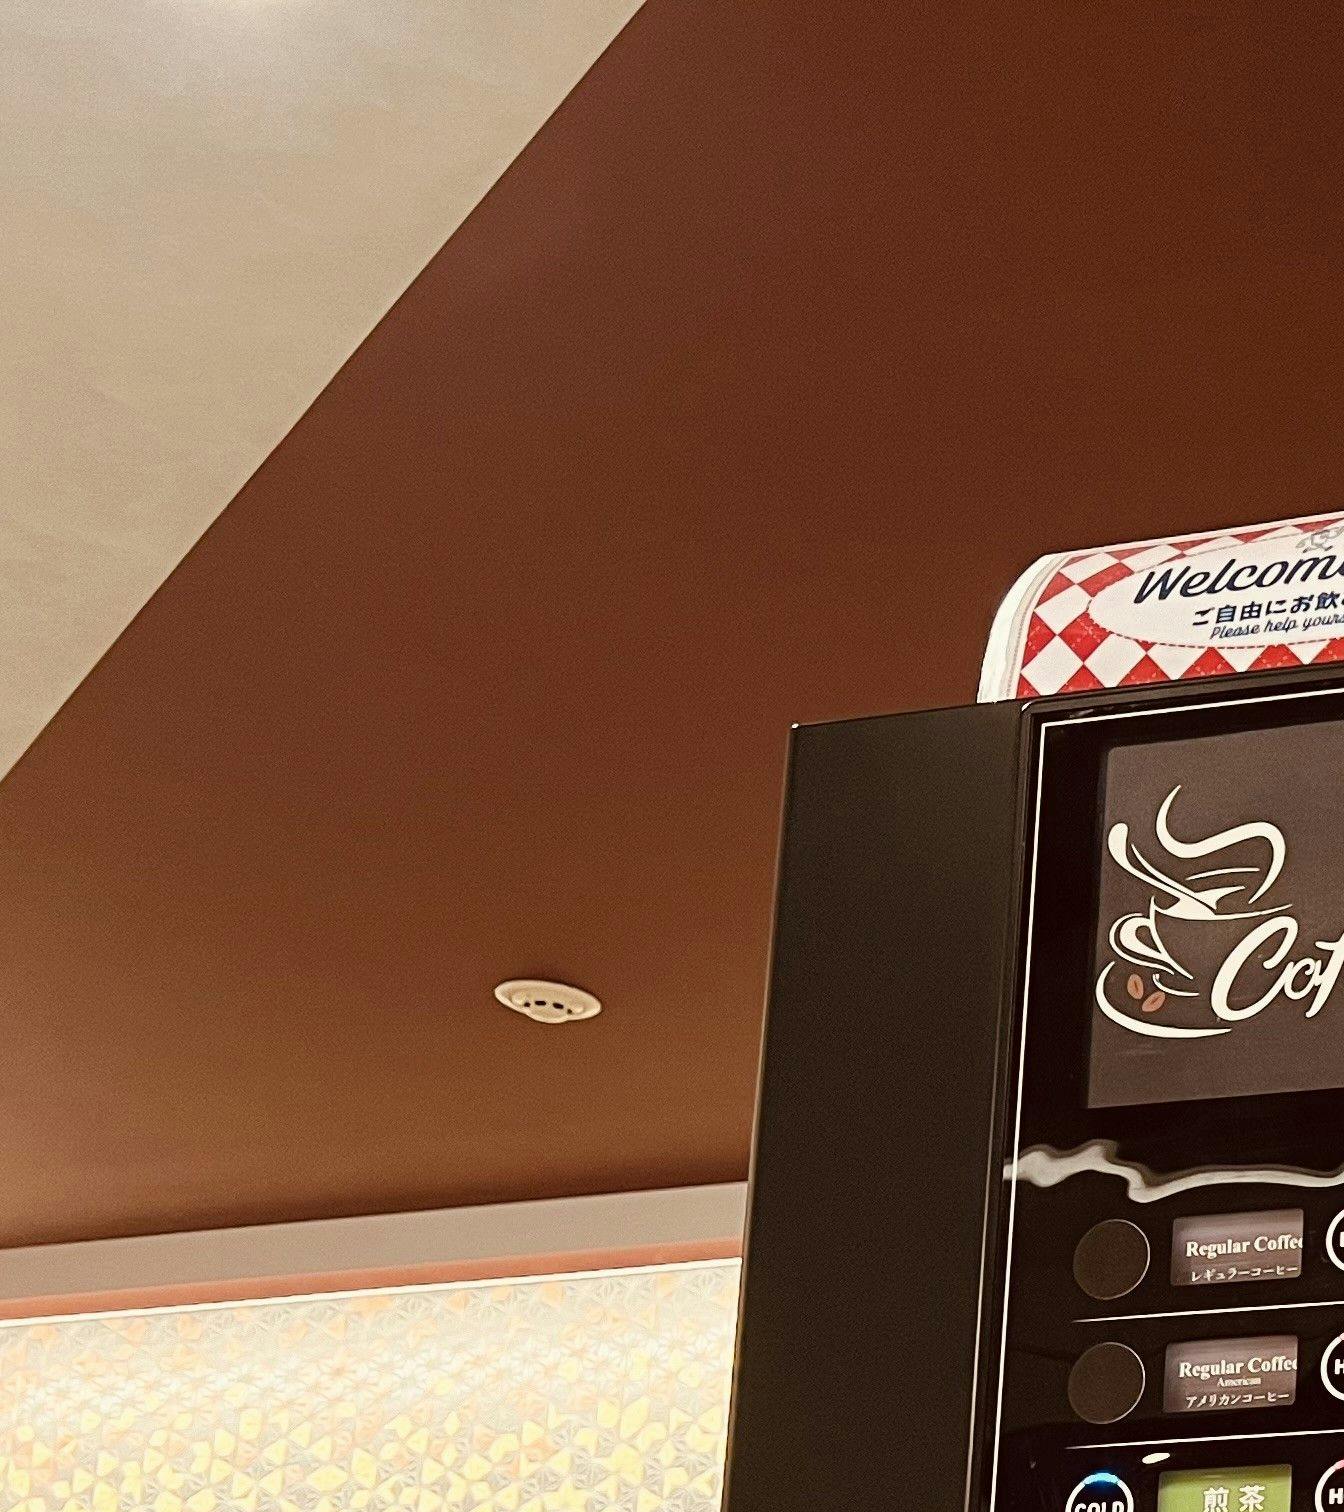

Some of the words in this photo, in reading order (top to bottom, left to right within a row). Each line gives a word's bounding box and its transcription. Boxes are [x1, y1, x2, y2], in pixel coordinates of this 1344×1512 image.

[1210, 623, 1261, 640] Please
[1264, 618, 1298, 634] help
[1185, 1238, 1250, 1260] Regular
[1191, 1265, 1298, 1282] レギュラーコーヒー
[1178, 1359, 1245, 1380] Regular
[1185, 1391, 1290, 1409] アメリカンコーヒー
